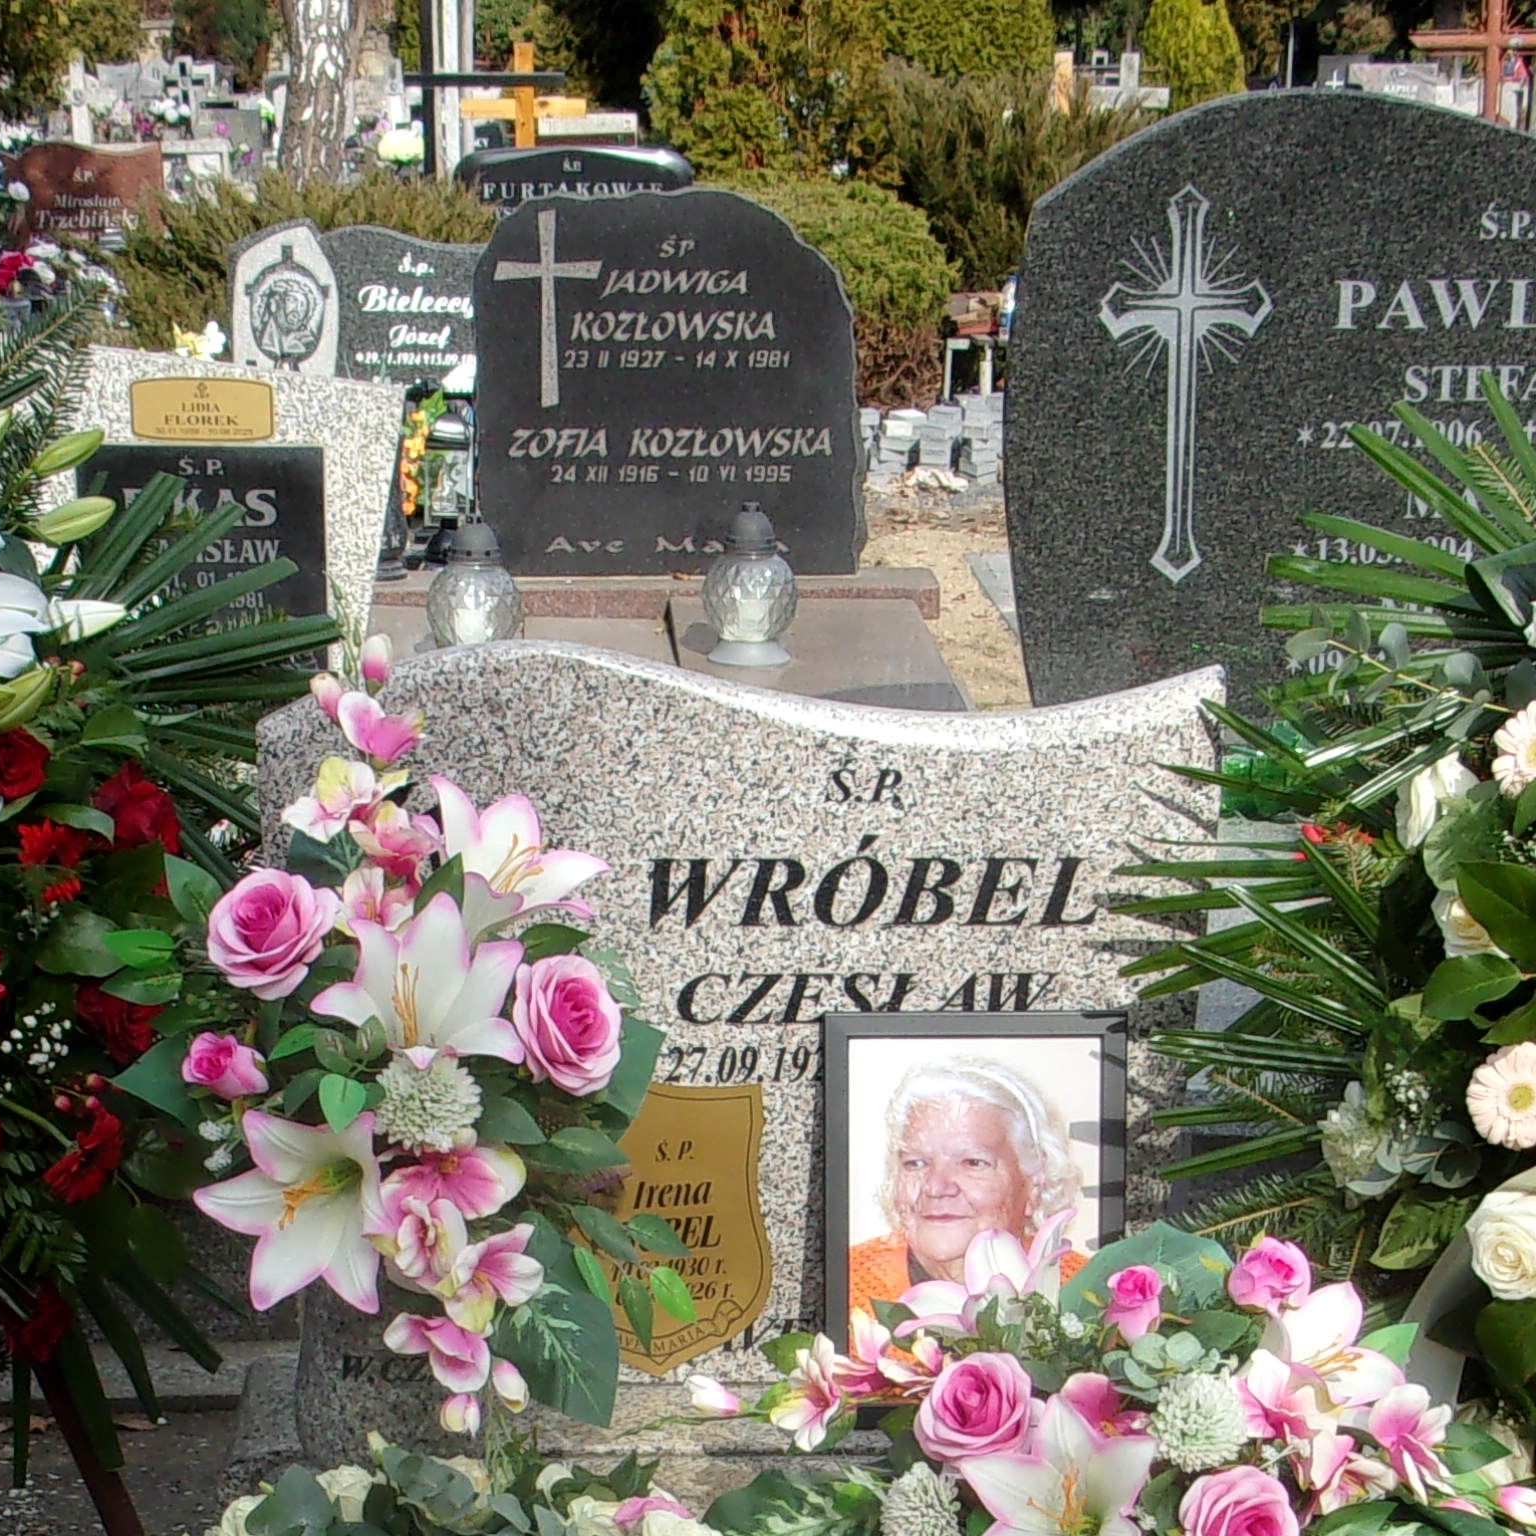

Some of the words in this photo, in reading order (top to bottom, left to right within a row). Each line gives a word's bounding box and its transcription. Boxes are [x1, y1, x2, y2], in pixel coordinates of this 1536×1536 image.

[1479, 203, 1535, 240] Ś.P.
[601, 269, 748, 299] JADWIGA
[570, 311, 776, 341] KOZŁOWSKA
[563, 350, 588, 368] 23
[619, 350, 664, 368] 1927
[696, 350, 715, 368] 14
[725, 350, 738, 368] X
[748, 350, 791, 369] 1981
[164, 414, 239, 426] FLOREK
[181, 402, 221, 413] LIDIA
[508, 428, 608, 458] ZOFIA
[629, 427, 833, 458] KOZŁOWSKA
[550, 464, 575, 483] 24
[586, 464, 608, 483] XII
[619, 464, 659, 483] 1916
[689, 464, 708, 483] 10
[720, 464, 736, 483] VI
[745, 464, 792, 483] 1995
[546, 535, 625, 554] Ave
[655, 536, 790, 554] Maa
[645, 833, 1101, 929] WRÓBEL
[676, 970, 1062, 1026] CZESŁAW
[633, 1180, 713, 1210] Irena
